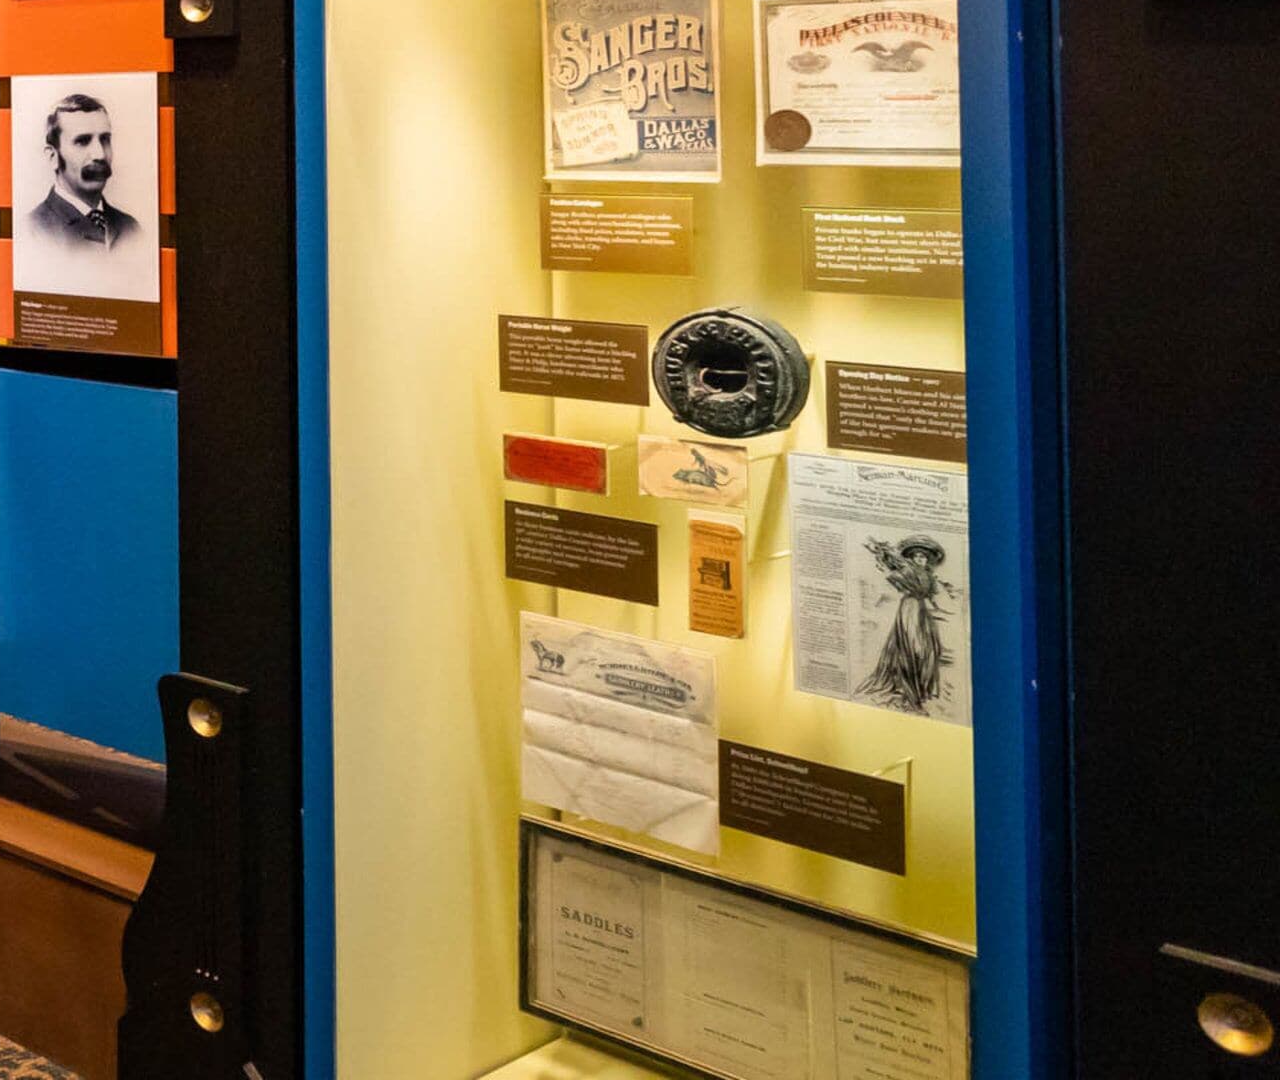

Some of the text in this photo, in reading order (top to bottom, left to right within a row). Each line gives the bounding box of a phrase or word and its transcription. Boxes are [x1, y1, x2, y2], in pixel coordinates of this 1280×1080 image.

[552, 13, 704, 93] SANGER
[643, 119, 709, 138] DALLAS
[560, 905, 634, 939] SADDLES
